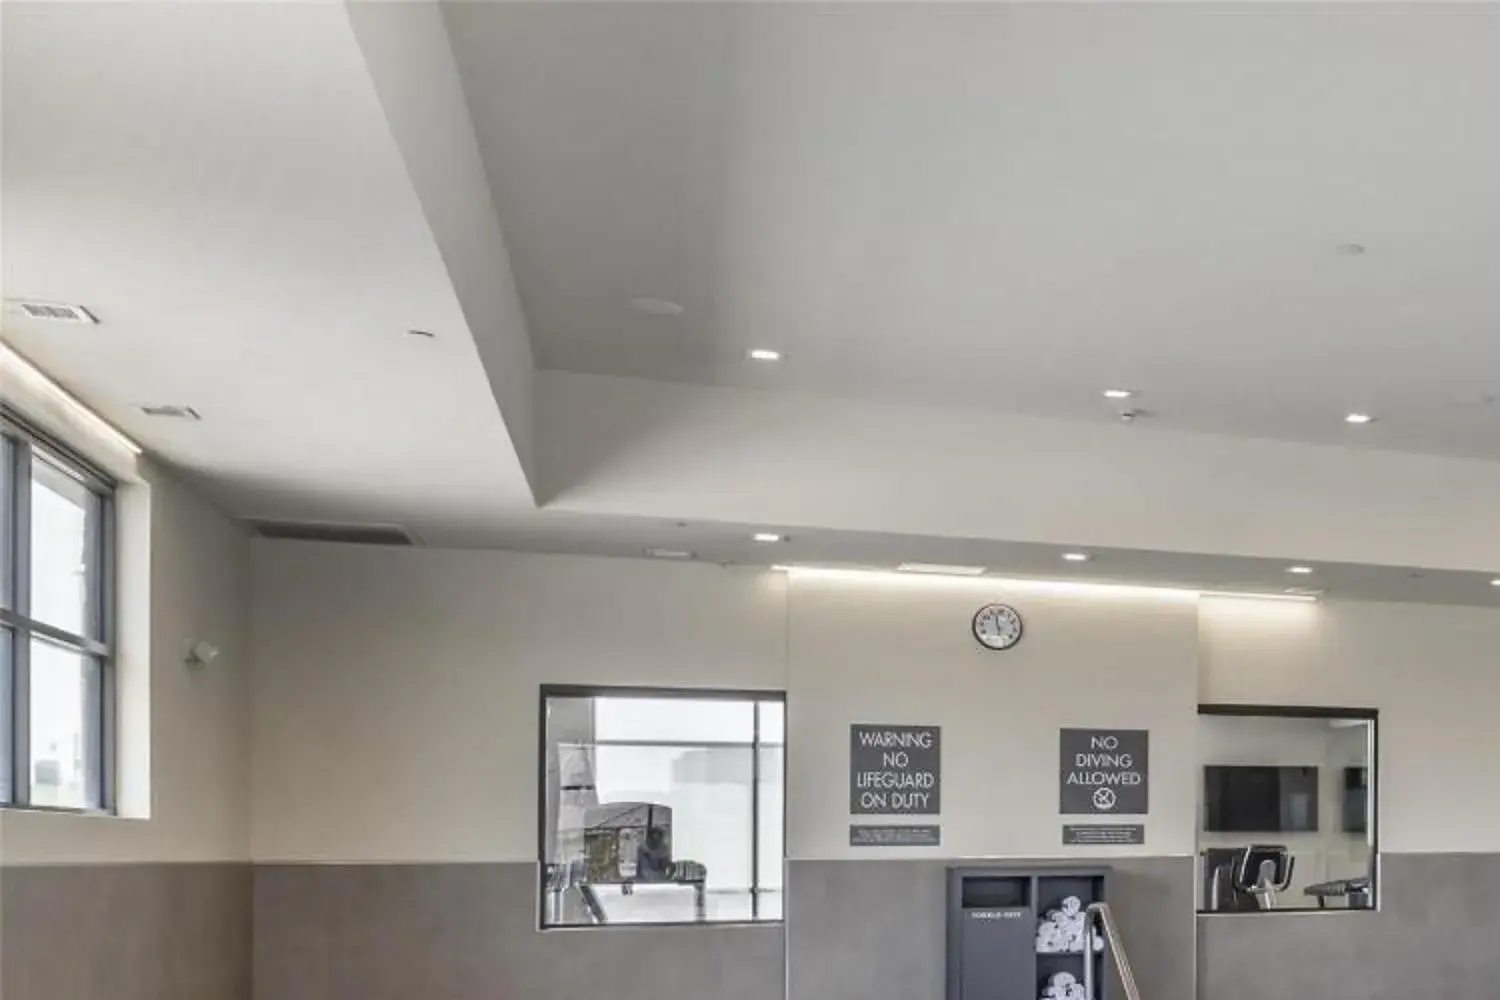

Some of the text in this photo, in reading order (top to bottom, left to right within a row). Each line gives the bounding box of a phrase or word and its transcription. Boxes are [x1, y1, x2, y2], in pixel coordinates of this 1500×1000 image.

[859, 732, 932, 748] WARNING
[1091, 735, 1119, 750] NO
[883, 751, 909, 768] NO
[1075, 753, 1133, 768] DIVING
[857, 772, 935, 789] LIFEGUARD
[1066, 771, 1141, 785] ALLOWED
[861, 791, 929, 808] ON DUTY
